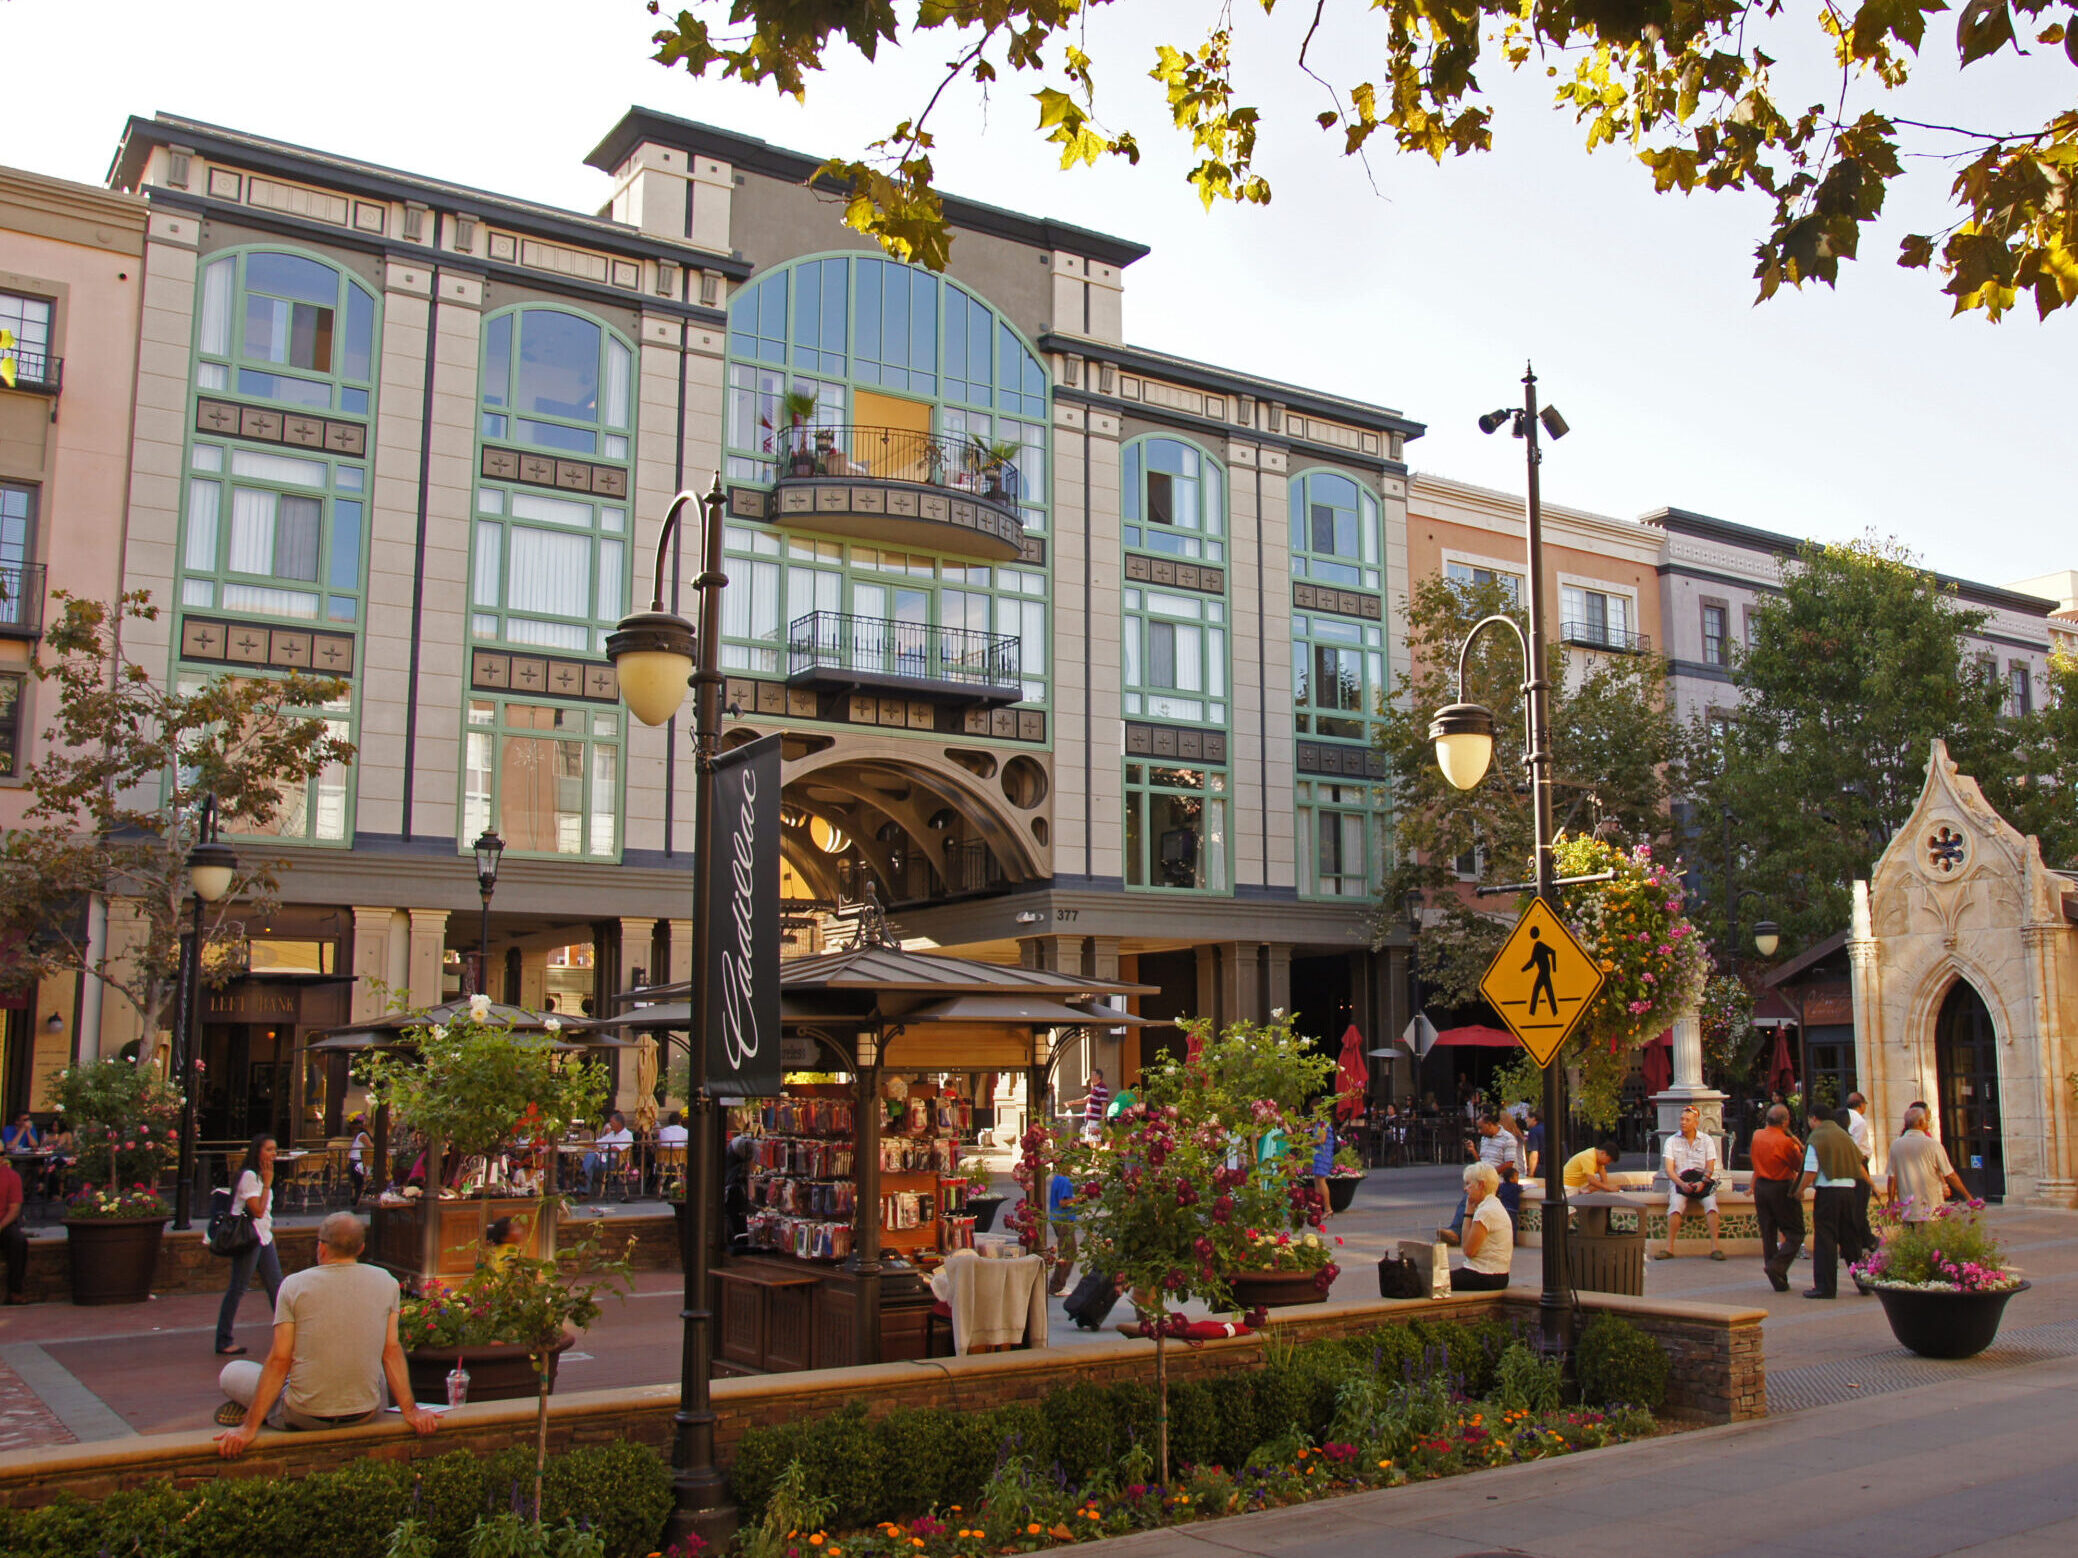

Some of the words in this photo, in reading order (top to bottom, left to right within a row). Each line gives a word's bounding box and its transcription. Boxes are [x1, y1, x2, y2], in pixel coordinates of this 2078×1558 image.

[722, 768, 757, 1070] Cadillac
[1057, 909, 1079, 922] 377
[210, 996, 246, 1012] LEFT
[258, 996, 294, 1012] BANK
